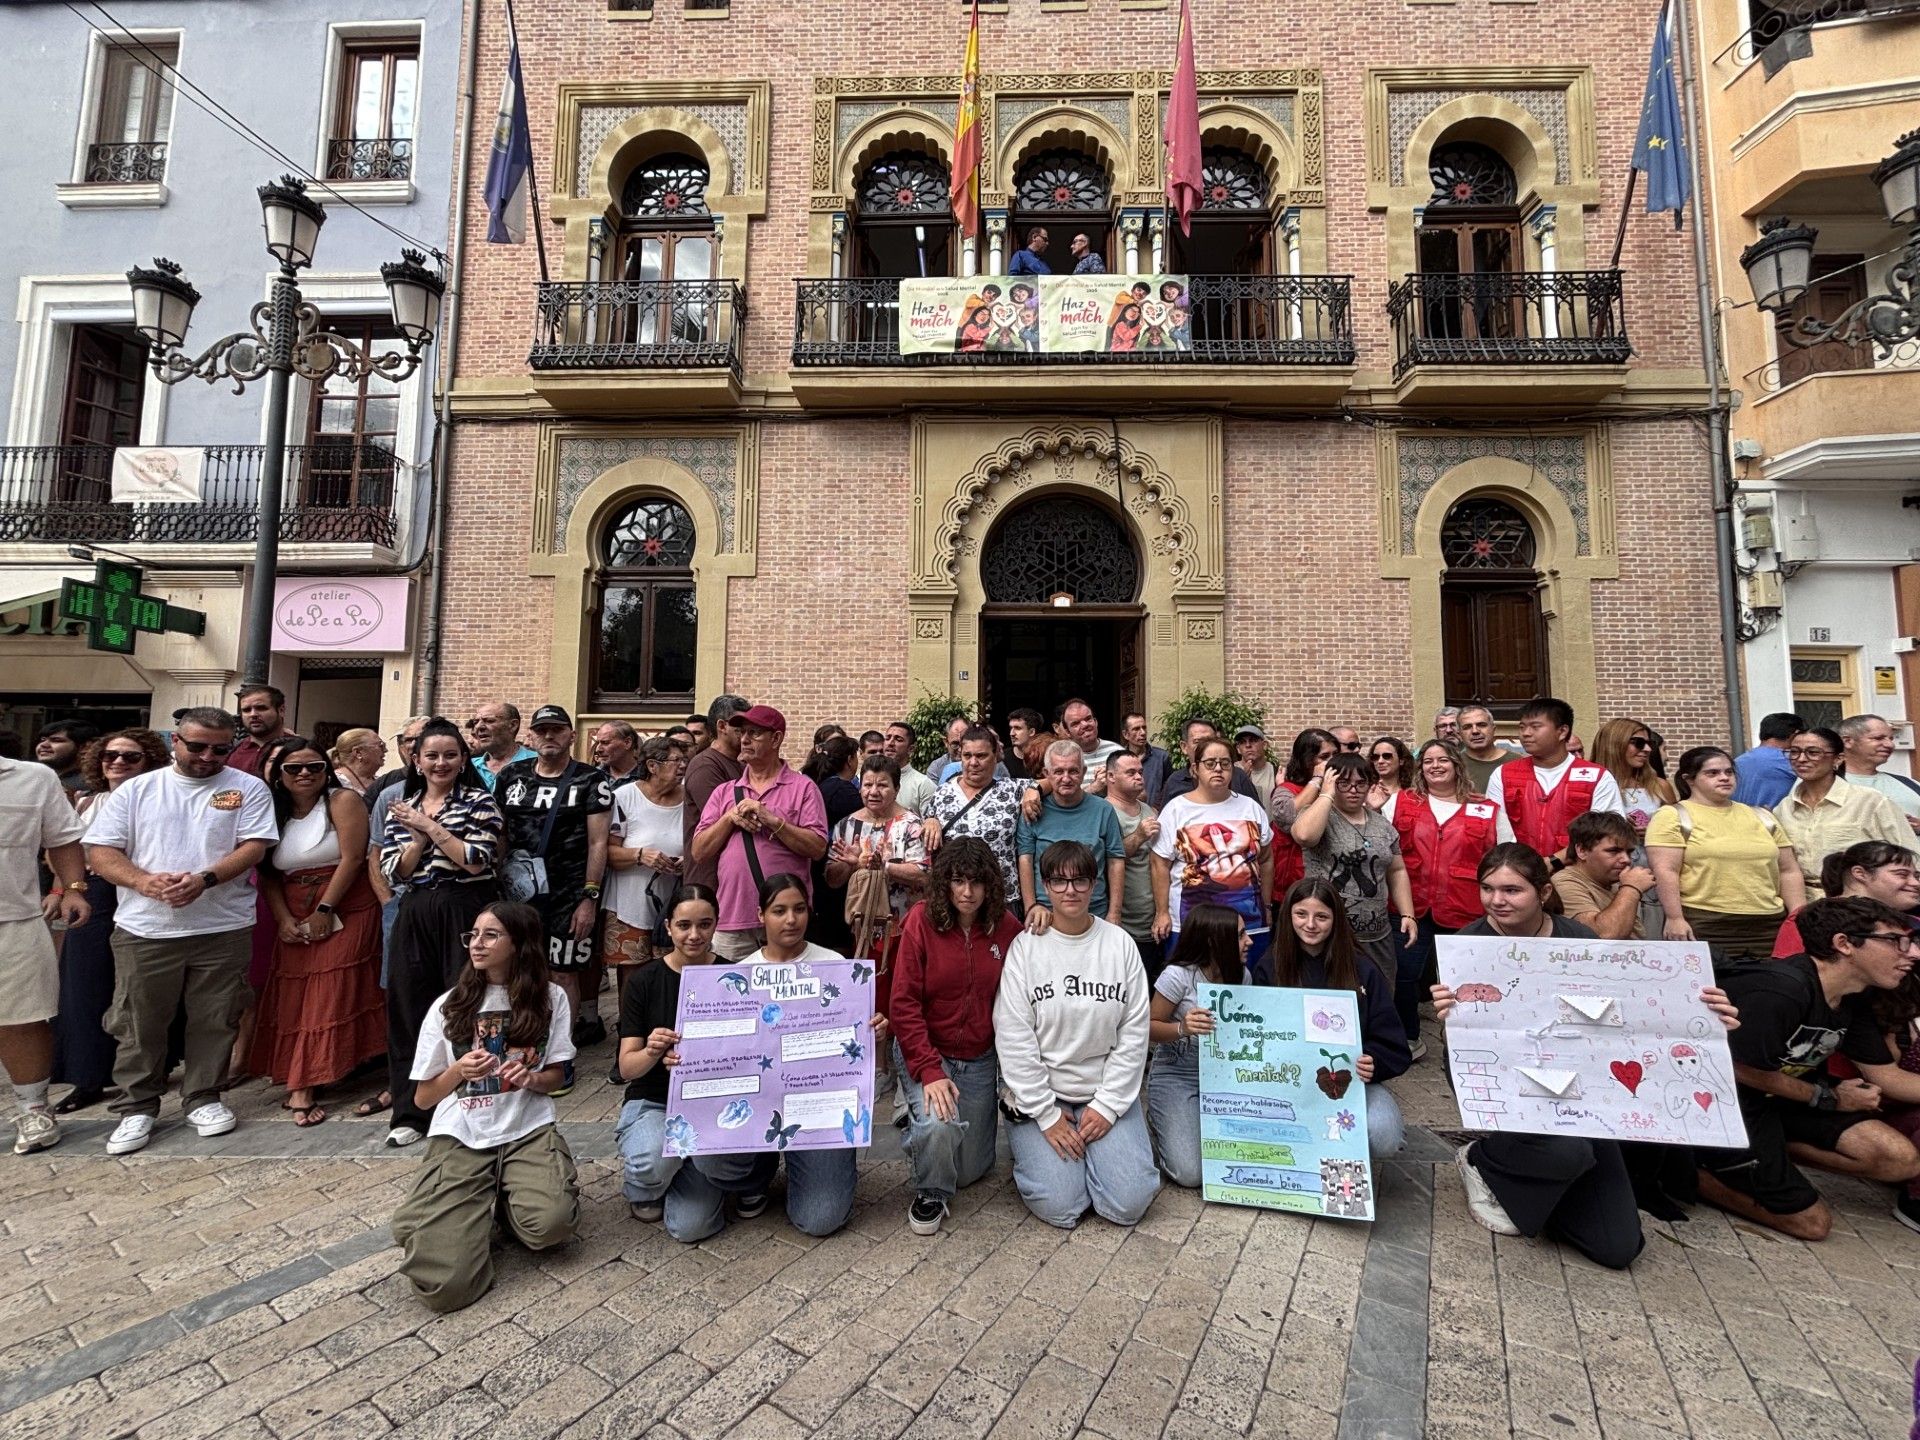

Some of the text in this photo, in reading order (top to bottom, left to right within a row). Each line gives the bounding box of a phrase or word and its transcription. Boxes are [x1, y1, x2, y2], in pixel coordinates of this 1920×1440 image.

[912, 301, 934, 316] Haz
[1062, 297, 1084, 311] Haz
[910, 311, 955, 328] match
[1060, 307, 1104, 324] match
[311, 590, 350, 600] atelier
[285, 609, 304, 626] de
[333, 617, 343, 626] a
[345, 604, 371, 626] Pa
[1813, 629, 1827, 640] 15
[753, 966, 790, 986] SALUD
[774, 982, 816, 999] MENTAL
[1239, 1025, 1297, 1048] mejorar
[1228, 1044, 1263, 1062] salud
[1235, 1063, 1301, 1087] mental?
[1202, 1095, 1241, 1105] Reconocer
[1203, 1104, 1262, 1115] lo que sentimos
[1280, 1173, 1302, 1191] bien
